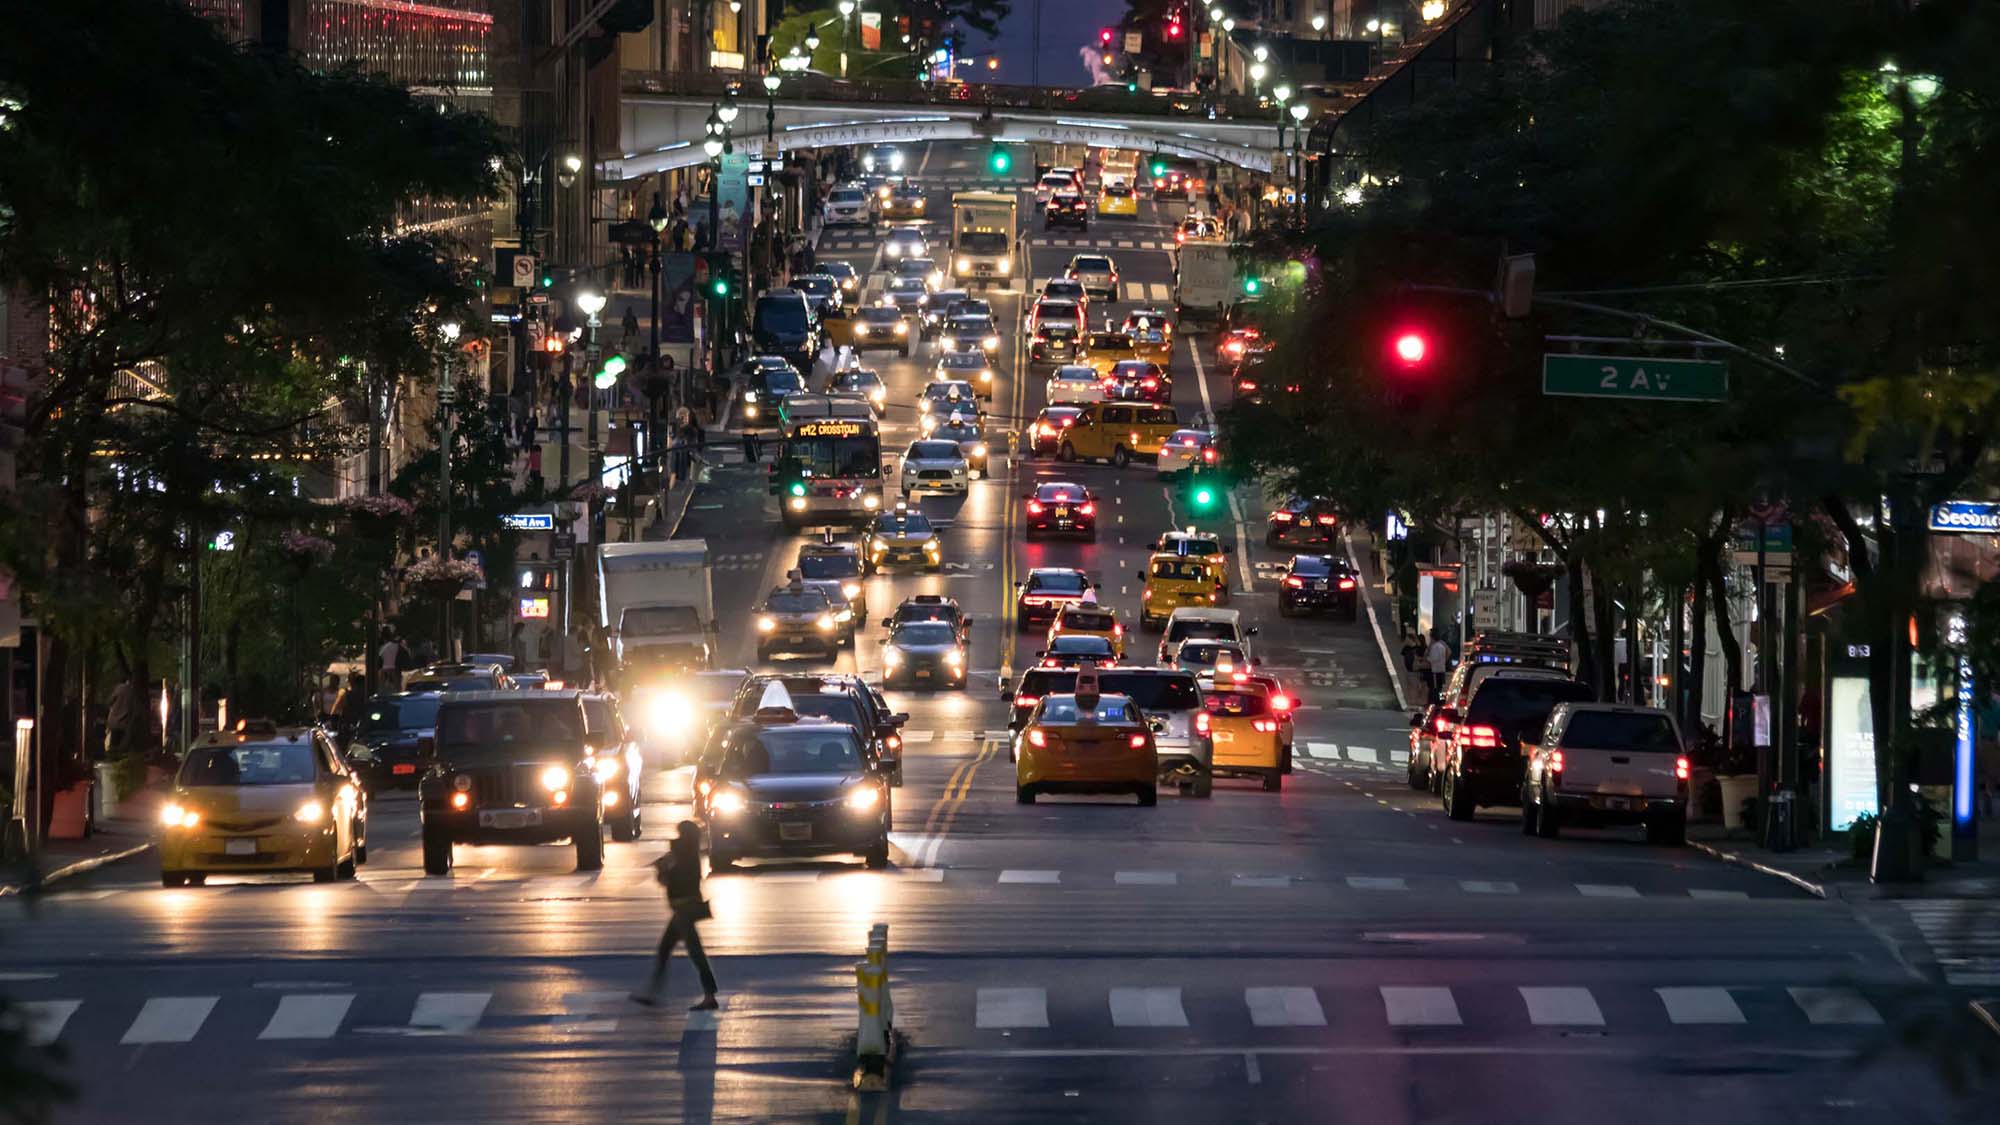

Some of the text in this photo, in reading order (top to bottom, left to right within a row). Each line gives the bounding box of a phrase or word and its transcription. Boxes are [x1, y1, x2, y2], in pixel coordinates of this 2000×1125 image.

[803, 127, 870, 142] SQUARE
[884, 125, 937, 137] PLAZA
[1039, 127, 1097, 140] GRAND
[1600, 366, 1618, 389] 2
[818, 423, 860, 435] CROSSTOWN
[528, 518, 546, 528] Ave
